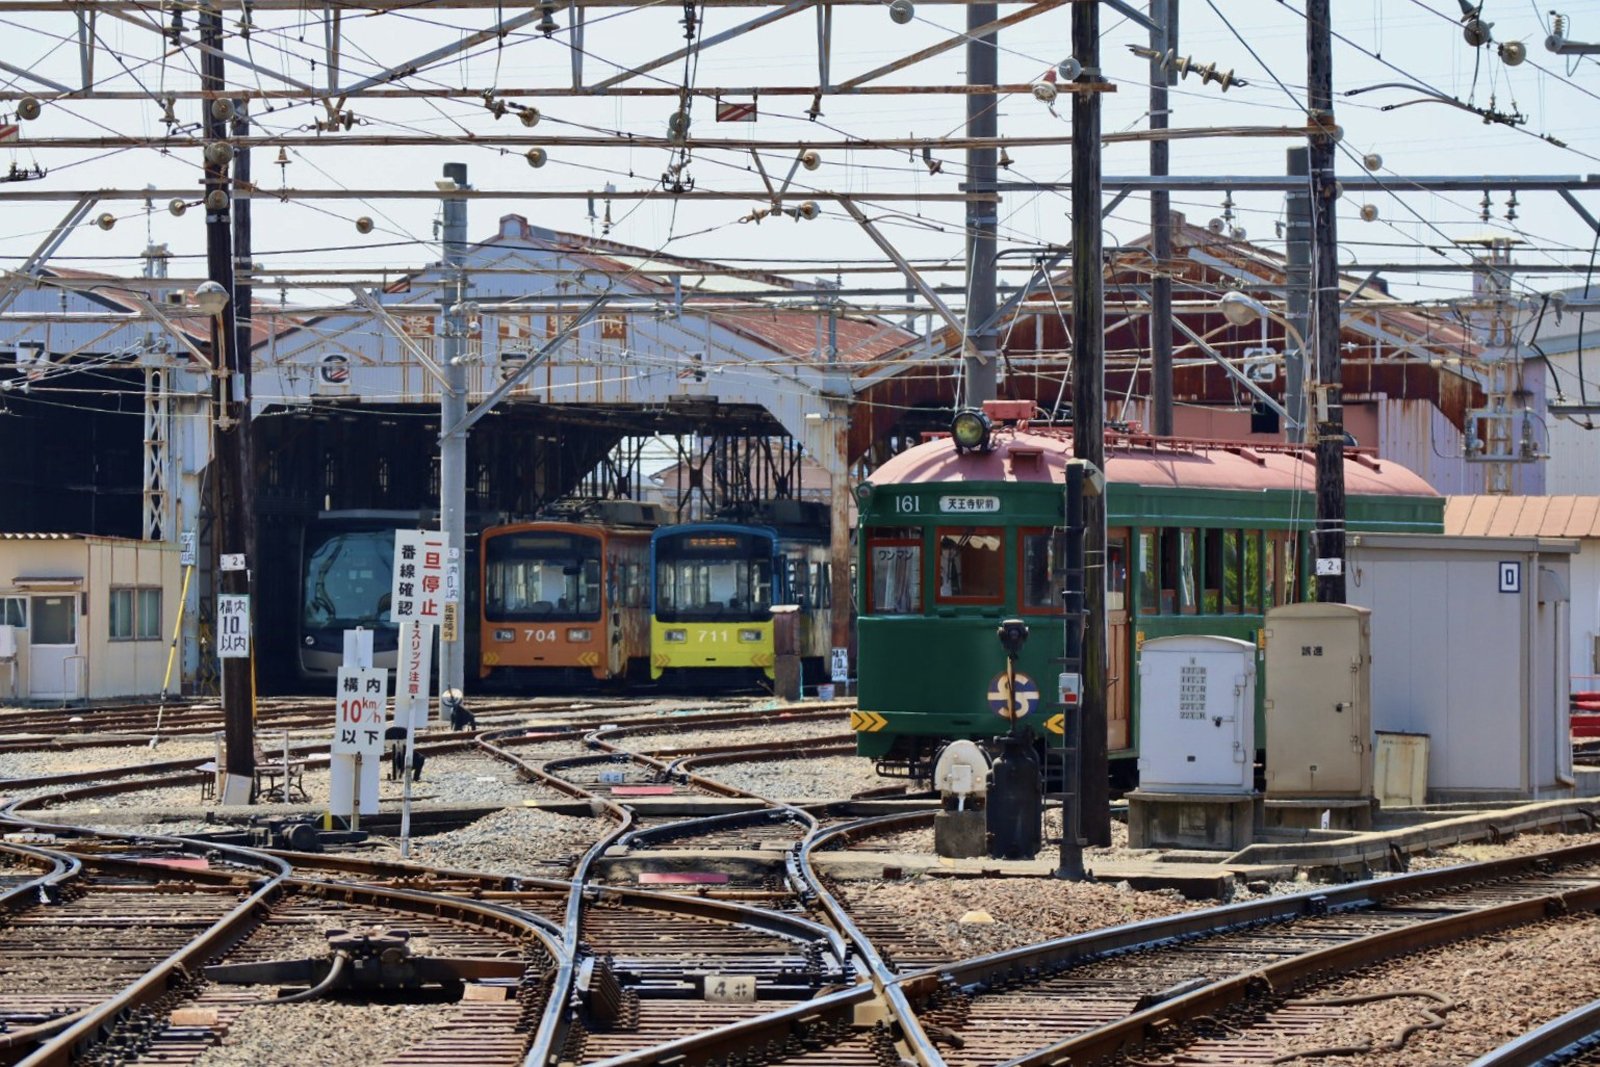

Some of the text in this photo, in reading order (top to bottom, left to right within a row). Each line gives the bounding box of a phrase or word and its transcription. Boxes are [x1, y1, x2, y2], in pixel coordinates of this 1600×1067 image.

[895, 495, 920, 512] 161
[948, 498, 994, 510] 天王寺駅前
[878, 550, 914, 561] ワンマン
[1328, 561, 1334, 570] 2
[398, 544, 416, 616] 番線確認
[420, 541, 442, 616] 一旦停止
[223, 616, 240, 634] 10
[220, 635, 246, 651] 以内
[524, 629, 556, 642] 704
[697, 630, 727, 642] 711
[408, 629, 421, 694] スリップ注意
[343, 677, 381, 694] 構内
[341, 729, 379, 745] 以下
